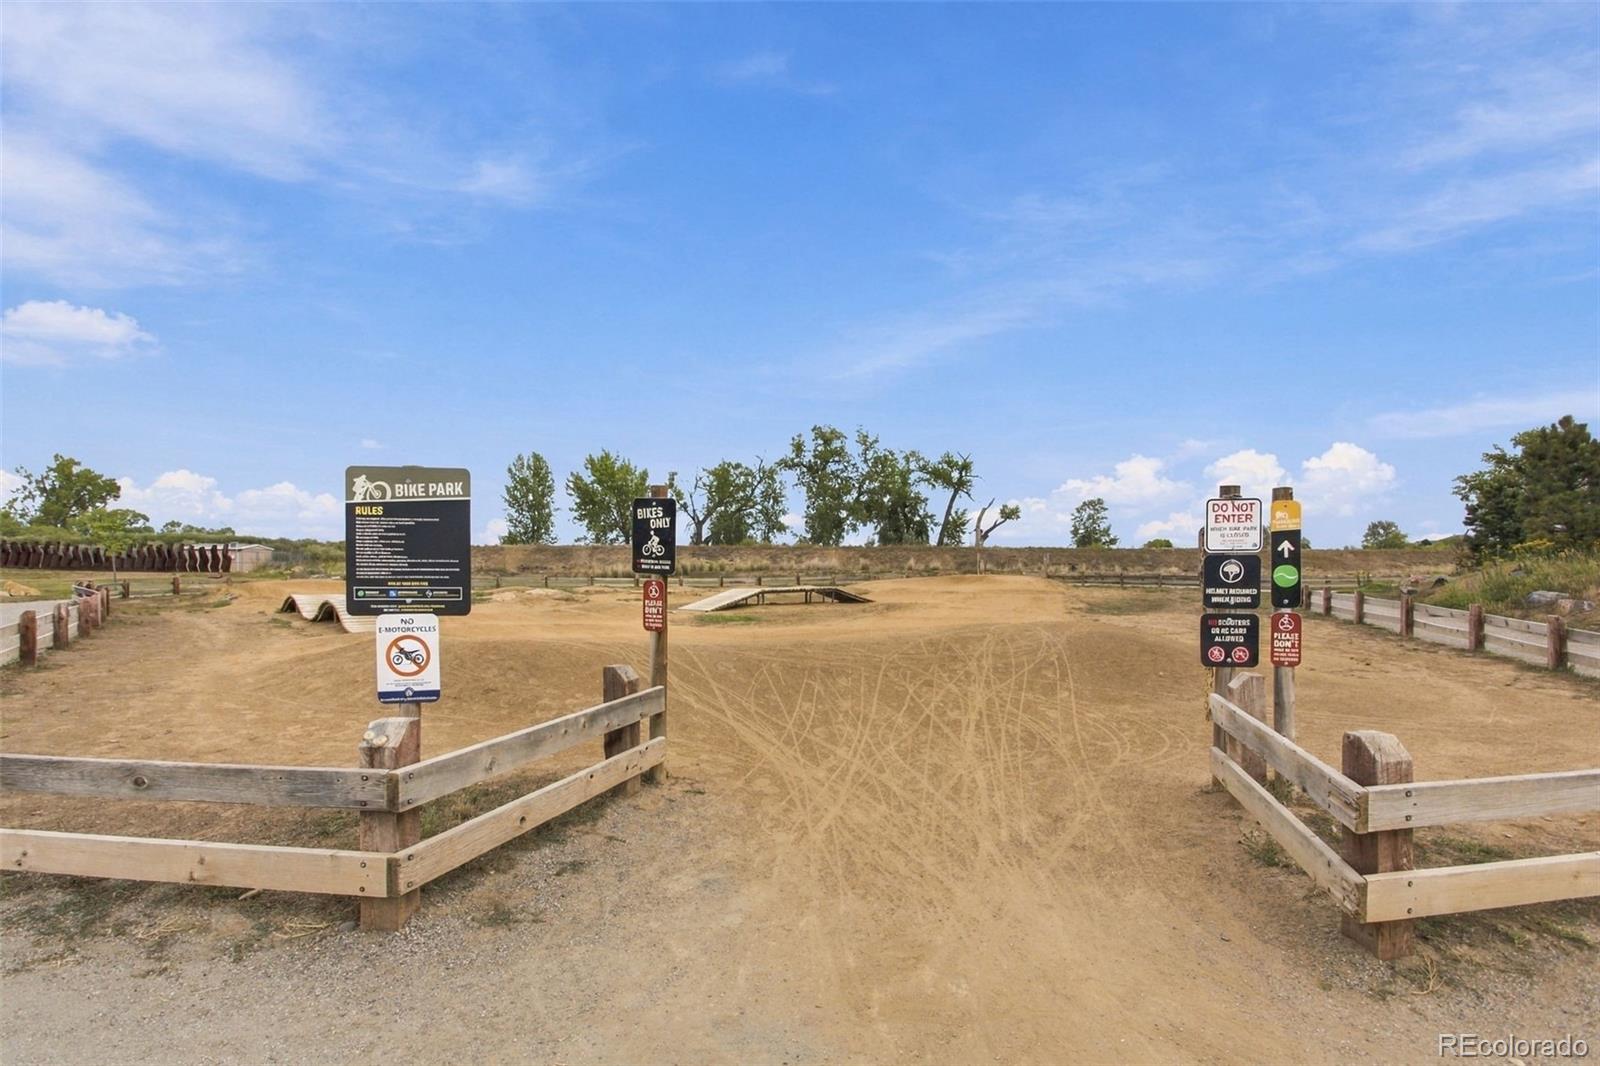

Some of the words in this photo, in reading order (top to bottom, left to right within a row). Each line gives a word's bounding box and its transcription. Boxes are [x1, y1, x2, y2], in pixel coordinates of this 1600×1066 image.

[395, 483, 426, 497] BIKE
[429, 482, 463, 496] PARK
[355, 506, 383, 515] RULES
[1212, 503, 1228, 512] DO
[1232, 502, 1255, 512] NOT
[637, 507, 663, 519] BIKES
[1214, 514, 1253, 523] ENTER
[650, 518, 671, 529] ONLY
[379, 625, 436, 633] E-MOTORCYCLES
[1274, 632, 1299, 640] PLEASE
[1274, 640, 1299, 648] DON'T
